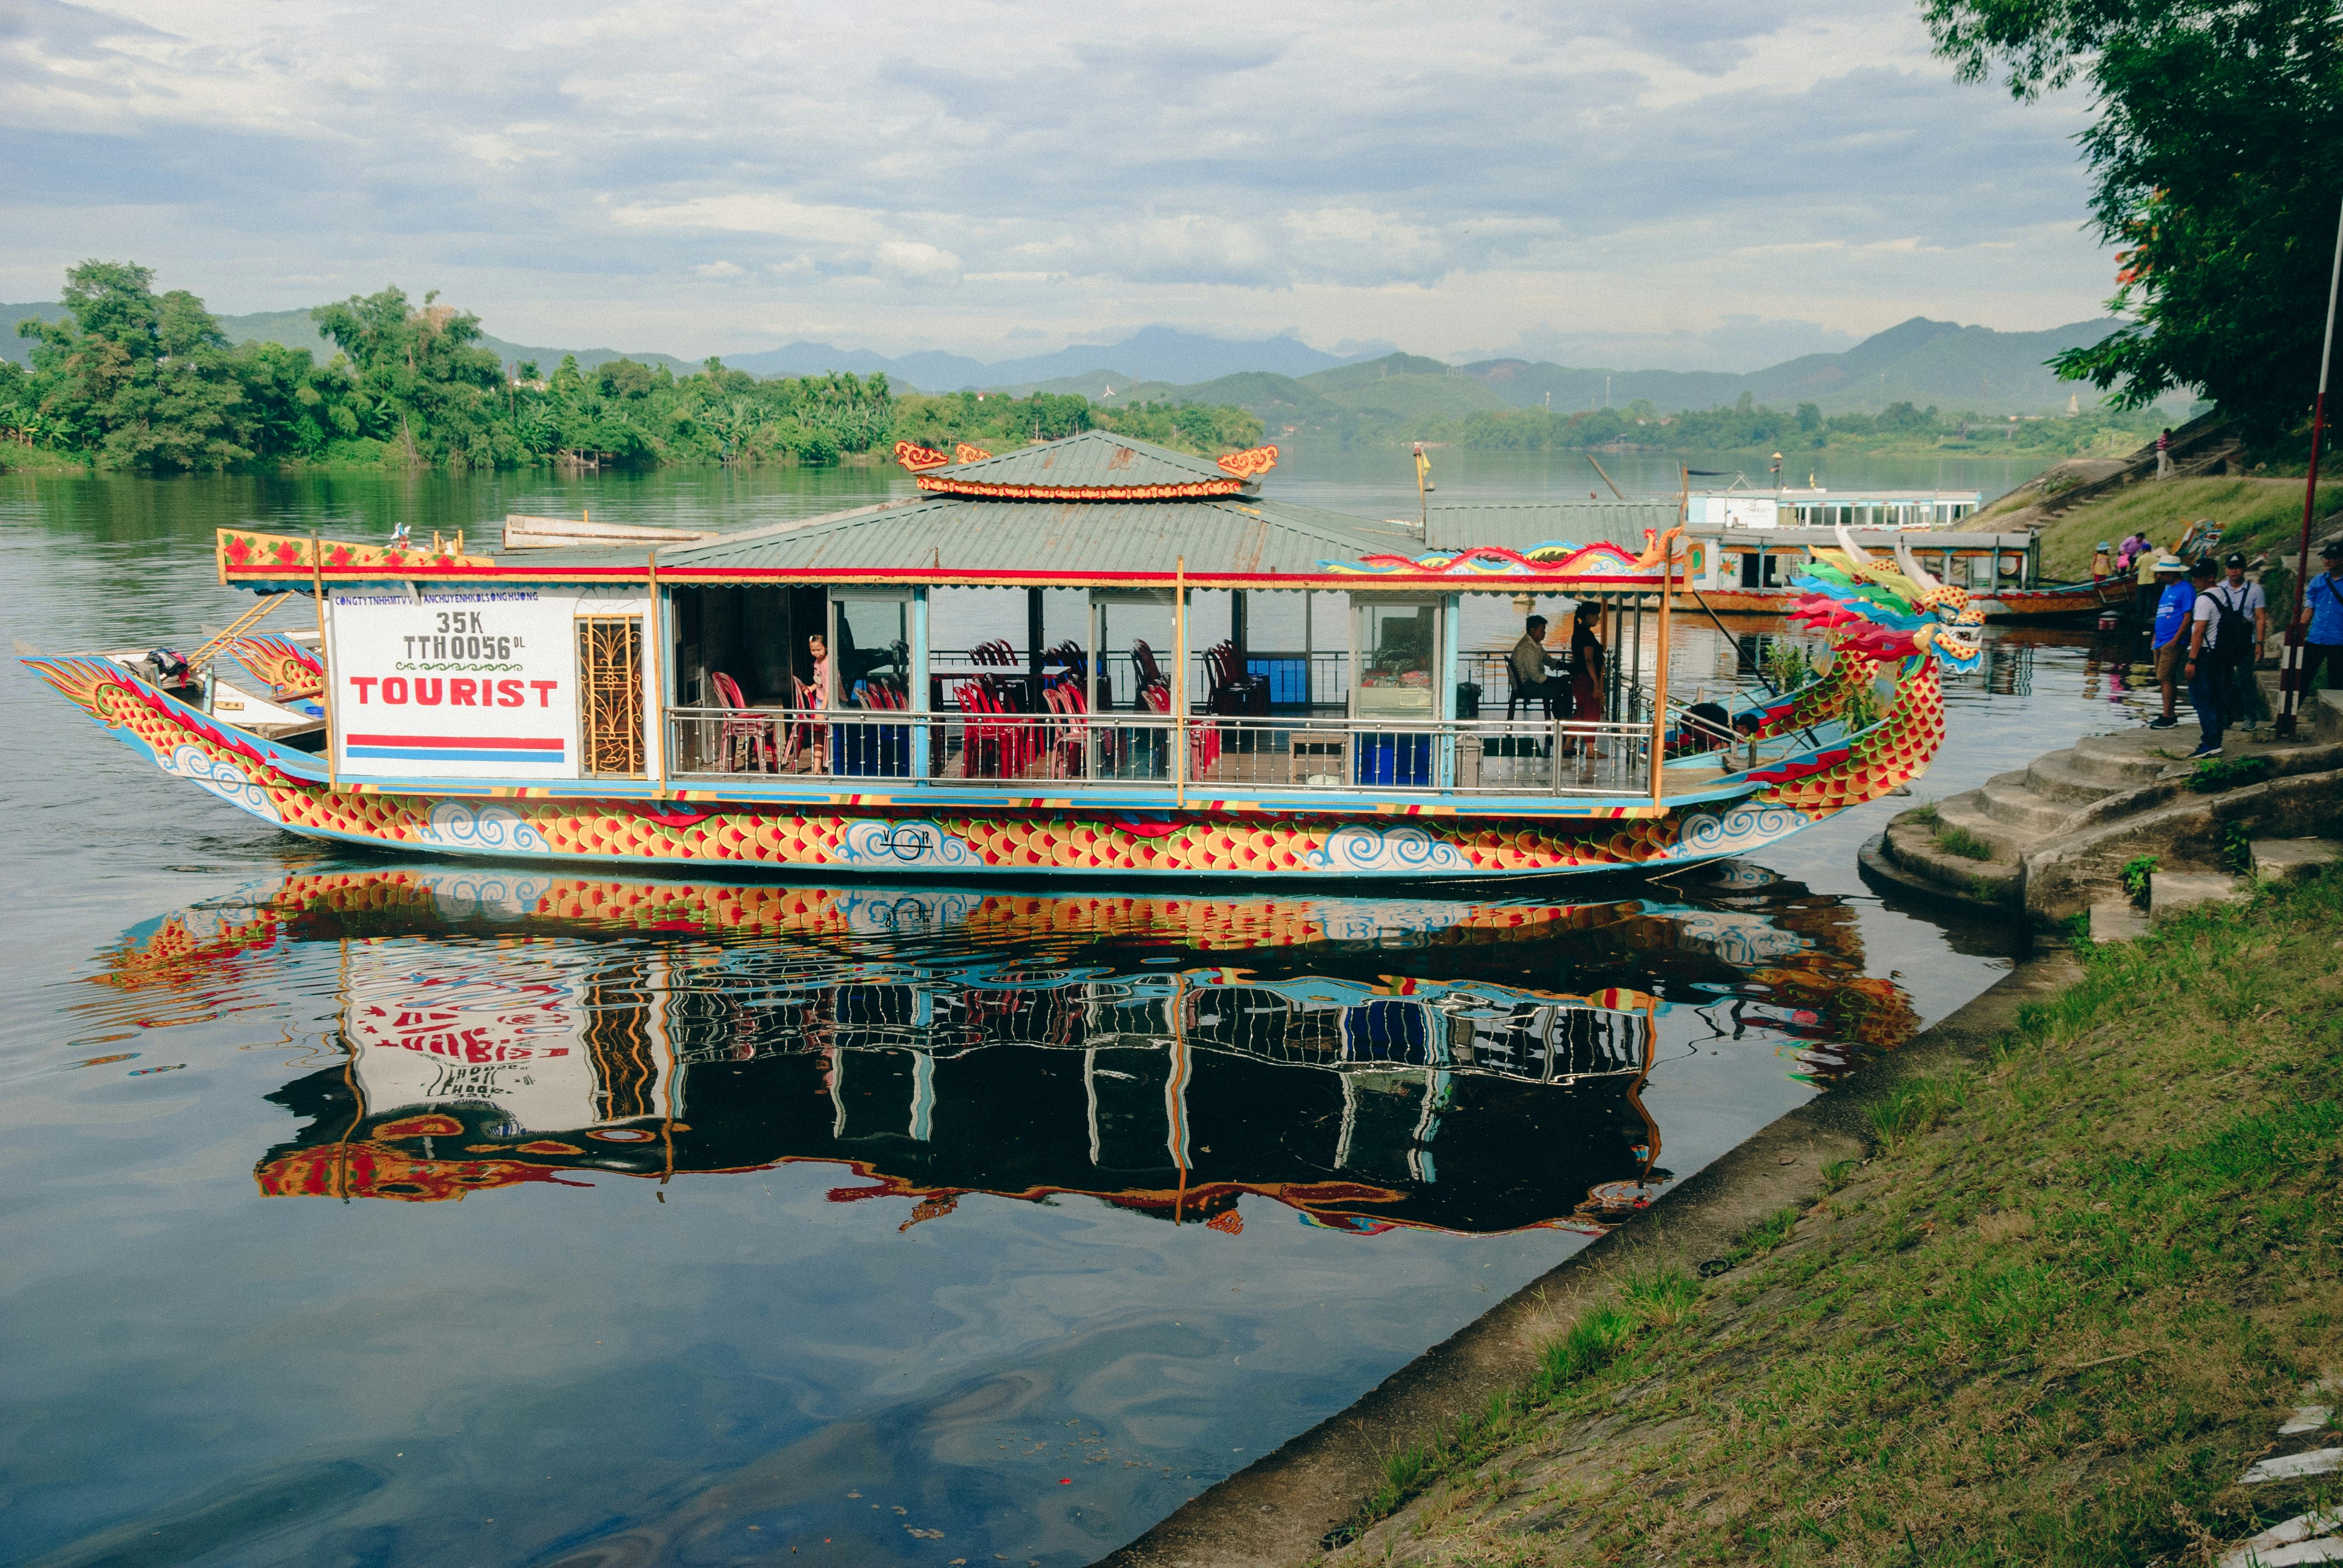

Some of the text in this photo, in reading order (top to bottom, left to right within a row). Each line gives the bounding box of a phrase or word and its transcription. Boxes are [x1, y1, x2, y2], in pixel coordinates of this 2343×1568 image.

[436, 612, 483, 634] 35K
[404, 636, 511, 659] TTH0056
[350, 676, 558, 708] TOURIST
